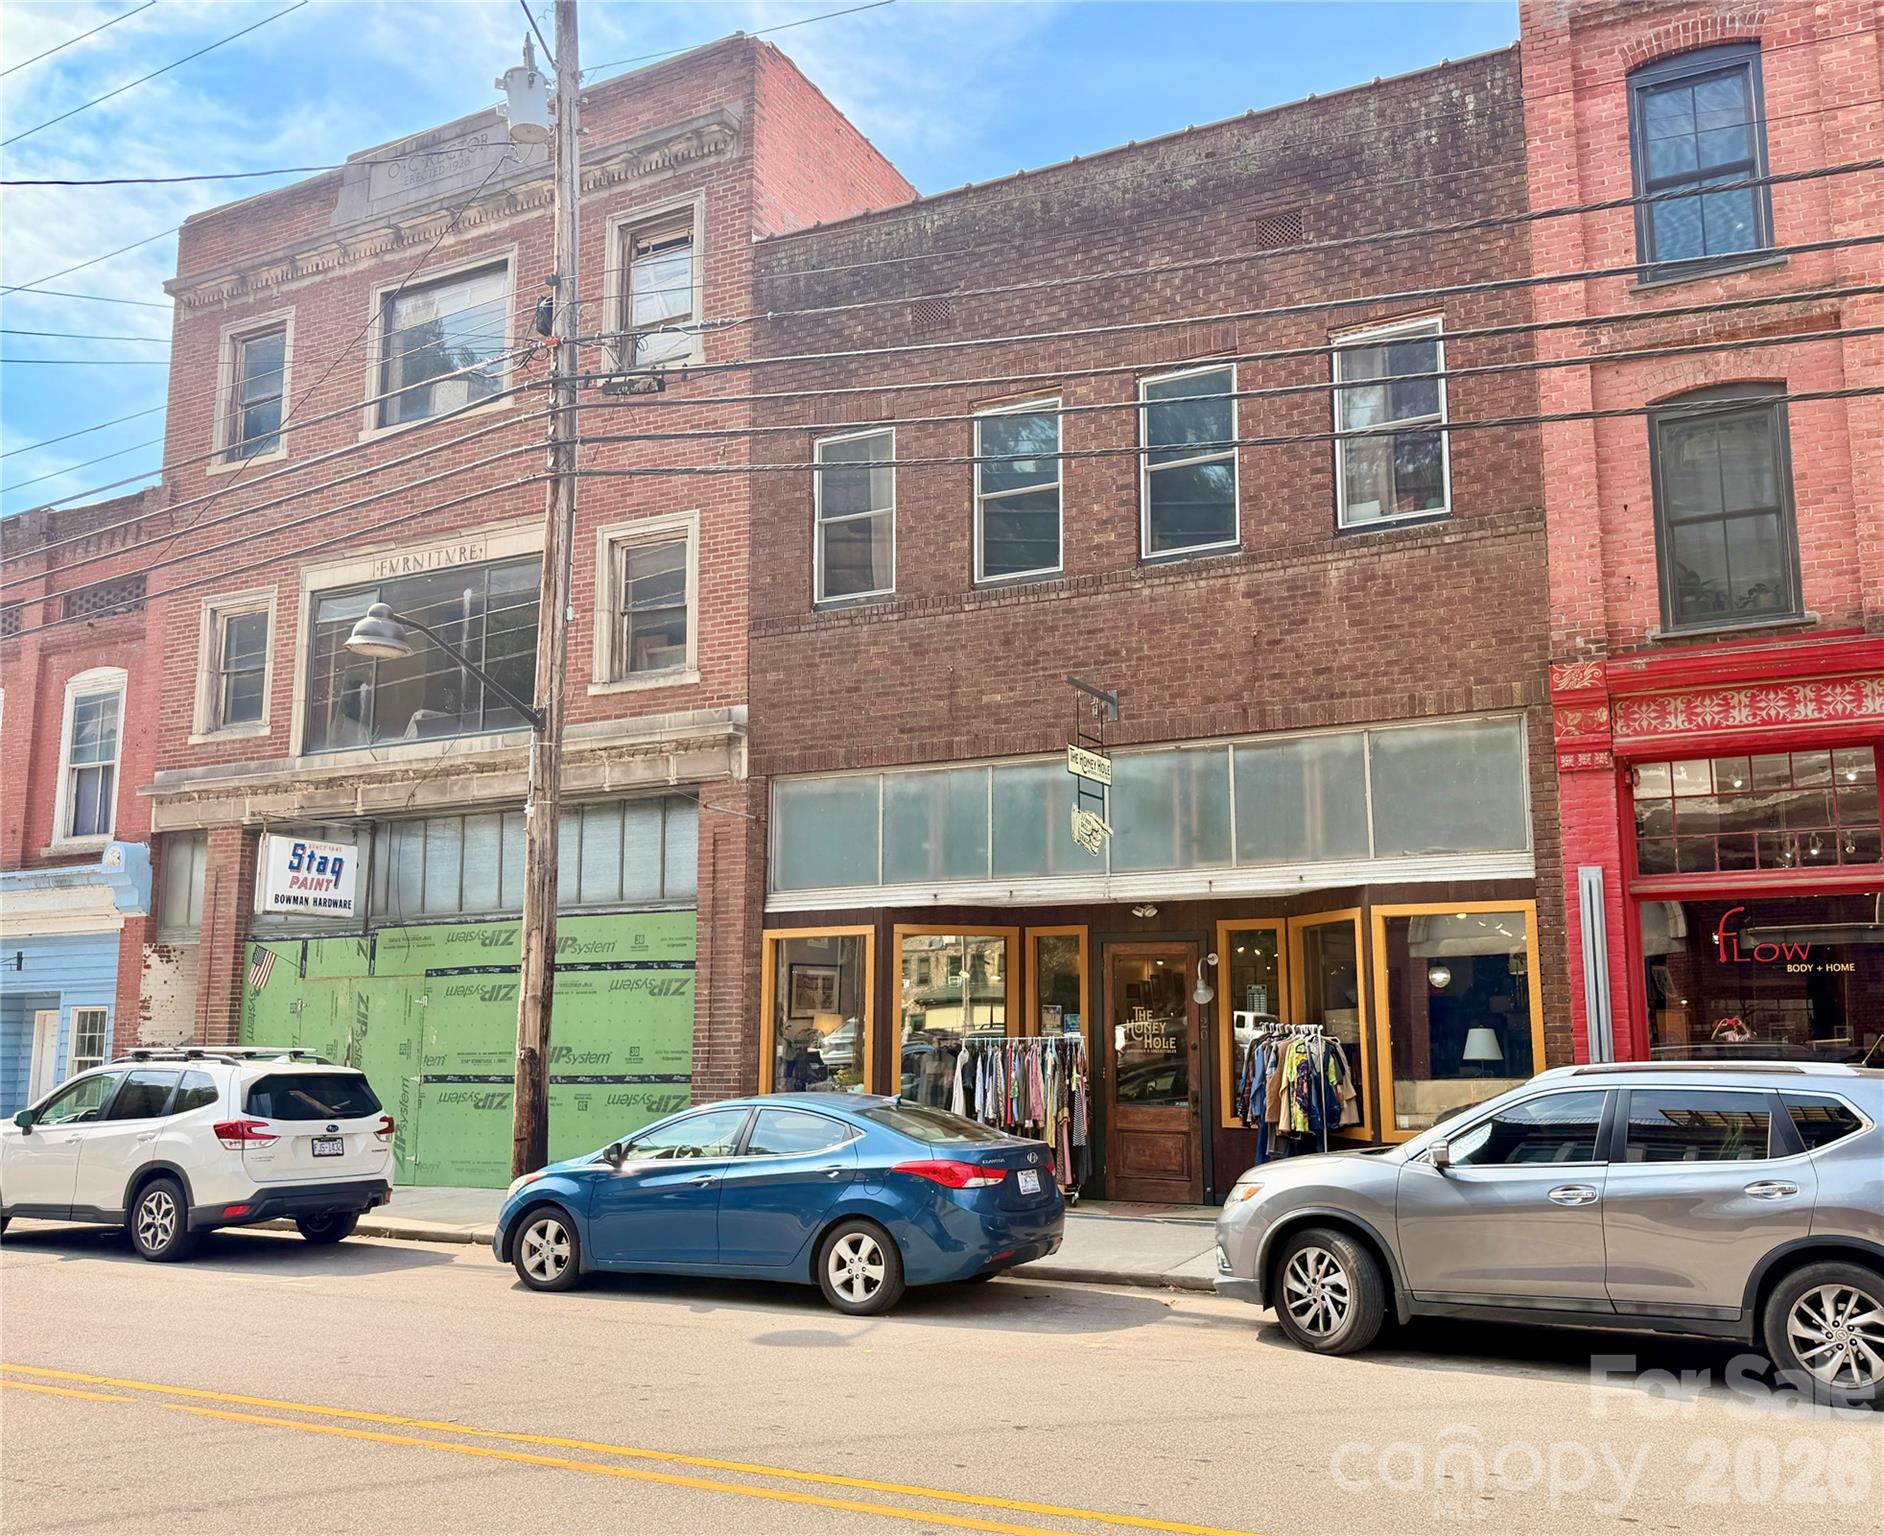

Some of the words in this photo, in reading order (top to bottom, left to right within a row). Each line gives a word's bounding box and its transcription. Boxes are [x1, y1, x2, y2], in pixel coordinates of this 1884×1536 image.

[288, 843, 345, 890] Stag
[289, 876, 333, 892] PAINT
[274, 893, 310, 907] BOWMAN
[313, 897, 352, 910] HARDWARE
[1786, 963, 1814, 973] BODY
[1826, 963, 1856, 972] HOME
[1132, 1006, 1153, 1021] THE
[1126, 1019, 1167, 1041] HONEY
[1144, 1034, 1177, 1049] HOLE
